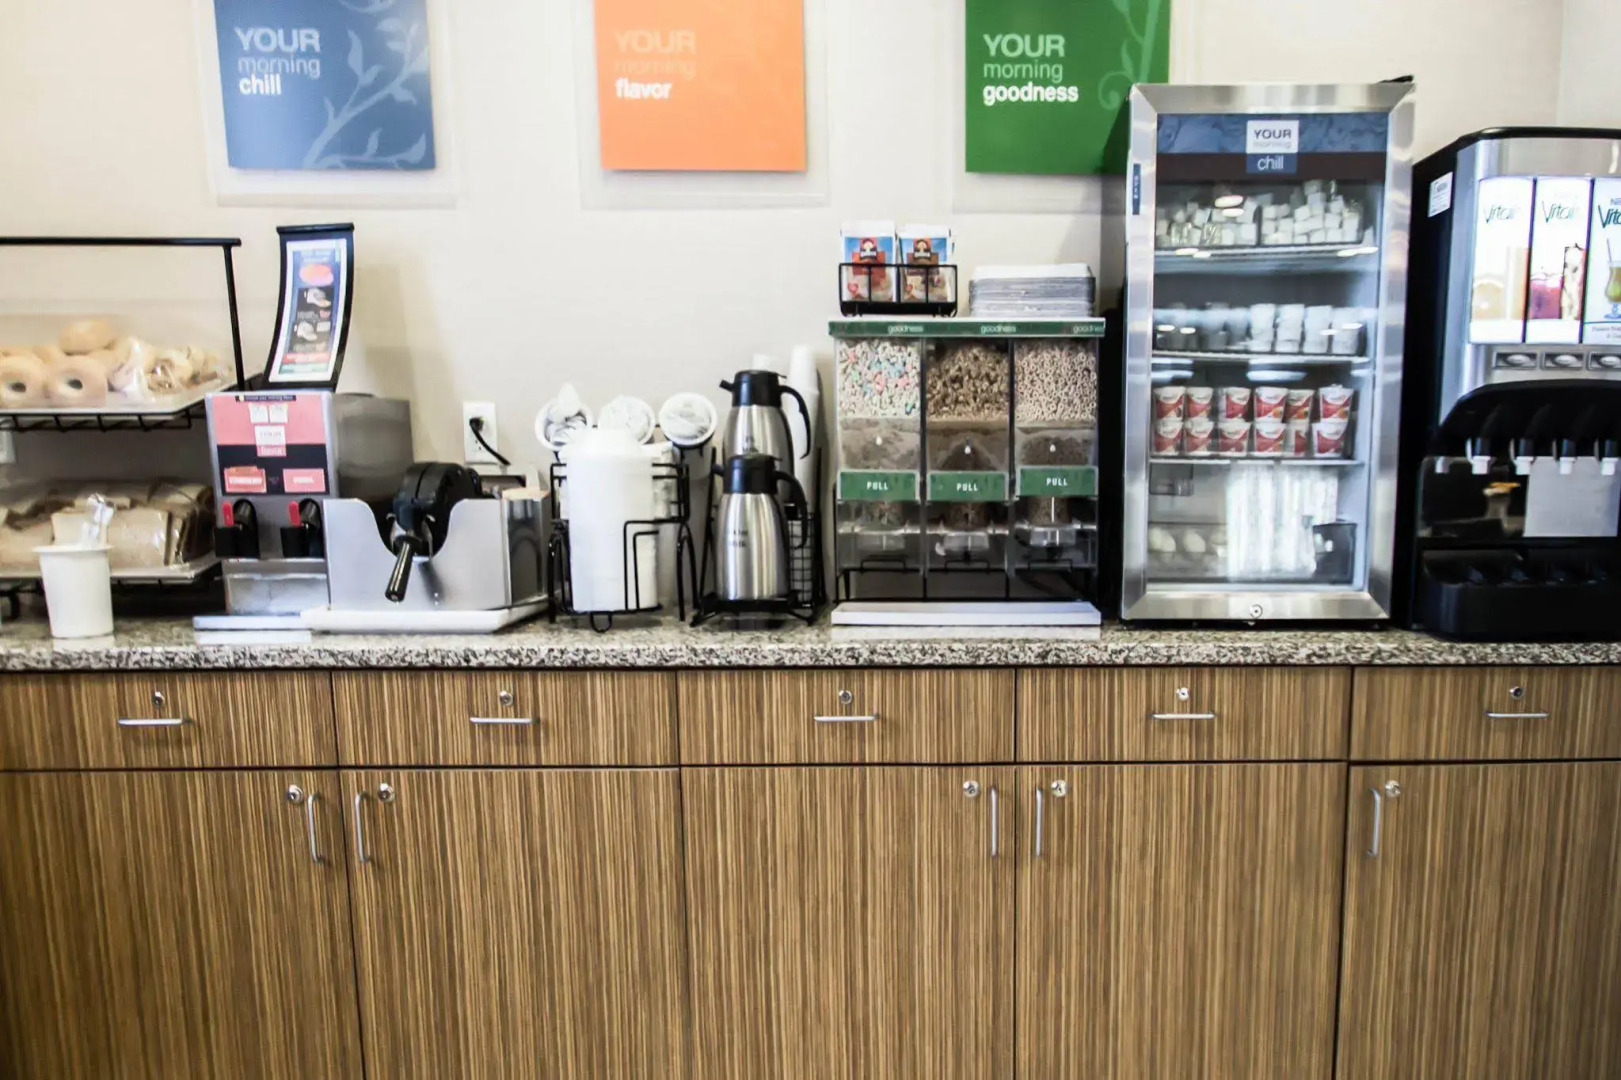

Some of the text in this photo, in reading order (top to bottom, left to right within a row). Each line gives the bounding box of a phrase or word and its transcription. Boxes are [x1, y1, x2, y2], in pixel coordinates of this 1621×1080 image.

[234, 27, 321, 53] YOUR
[614, 29, 697, 55] YOUR
[983, 33, 1066, 57] YOUR
[237, 57, 321, 79] morning
[614, 59, 697, 81] morning
[983, 60, 1064, 84] morning
[239, 73, 282, 96] chill
[615, 77, 673, 99] flavor
[983, 81, 1080, 107] goodness
[1254, 129, 1292, 139] YOUR
[1257, 155, 1284, 171] chill
[887, 324, 924, 336] goodness
[980, 324, 1017, 336] goodness
[866, 481, 889, 491] PULL
[956, 482, 979, 492] PULL
[1046, 477, 1068, 487] PULL
